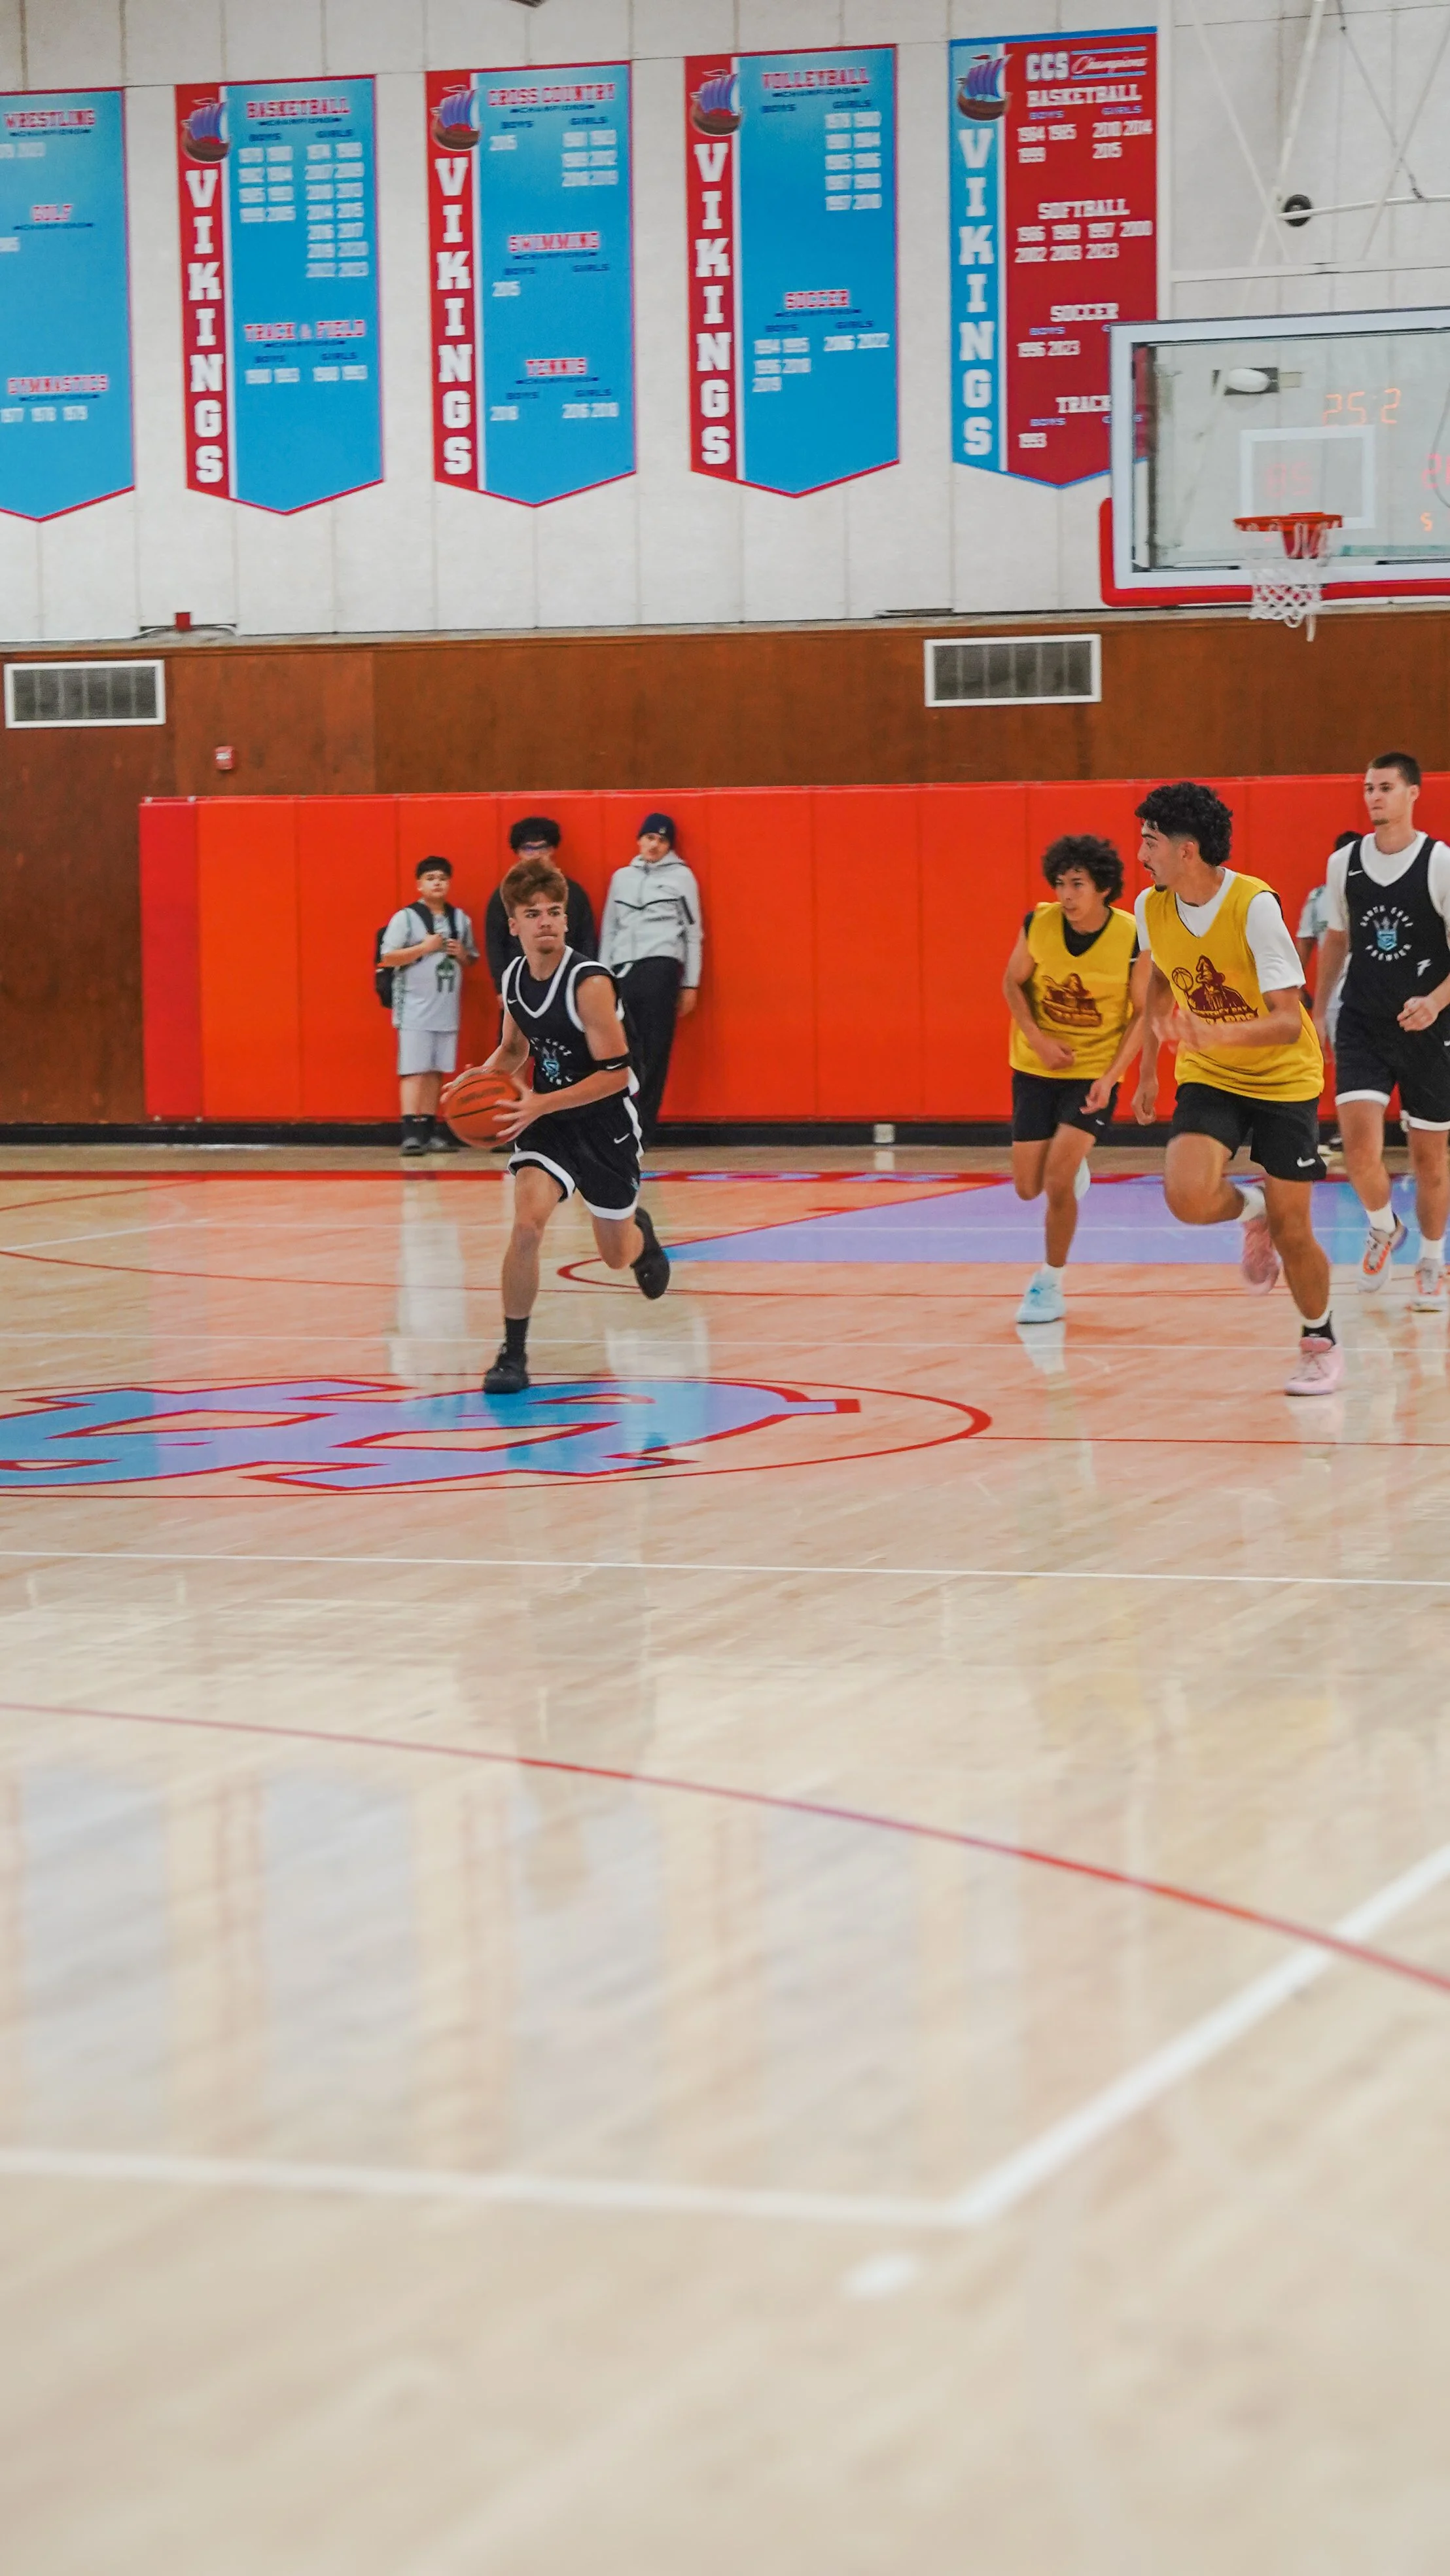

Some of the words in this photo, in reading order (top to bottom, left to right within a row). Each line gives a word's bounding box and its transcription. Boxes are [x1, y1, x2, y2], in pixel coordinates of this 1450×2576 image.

[1026, 51, 1069, 82] CCS
[762, 67, 869, 90] VOLLEYBALL
[487, 87, 538, 106] CROSS
[542, 82, 616, 103] COUNTRY
[1026, 84, 1143, 107] BASKETBALL
[246, 97, 351, 119] BASKETBALL
[761, 103, 797, 113] BOYS
[832, 99, 872, 109] GIRLS
[1029, 110, 1065, 120] BOYS
[1101, 105, 1142, 115] GIRLS
[3, 109, 96, 128] WRESTLING
[500, 120, 535, 129] BOYS
[569, 116, 609, 125] GIRLS
[249, 133, 282, 142] BOYS
[315, 129, 353, 138] GIRLS
[31, 204, 73, 223] GOLF
[1038, 198, 1131, 219] SOFTBALL
[508, 231, 599, 253] SWIMMING
[504, 267, 537, 276] BOYS
[573, 263, 610, 272] GIRLS
[784, 289, 849, 310] SOCCER
[958, 128, 994, 456] VIKINGS
[694, 142, 730, 465] VIKINGS
[1050, 302, 1119, 322] SOCCER
[186, 169, 223, 483] VIKINGS
[435, 158, 471, 474] VIKINGS
[765, 323, 799, 332] BOYS
[835, 320, 874, 329] GIRLS
[244, 322, 296, 342] TRACK
[300, 324, 312, 339] &
[315, 319, 365, 339] FIELD
[1029, 327, 1066, 335] BOYS
[321, 352, 358, 361] GIRLS
[525, 357, 587, 377] TENNIS
[8, 374, 109, 395] GYMNASTICS
[575, 388, 612, 397] GIRLS
[1030, 418, 1066, 426] BOYS
[1390, 906, 1414, 927] CRUZ
